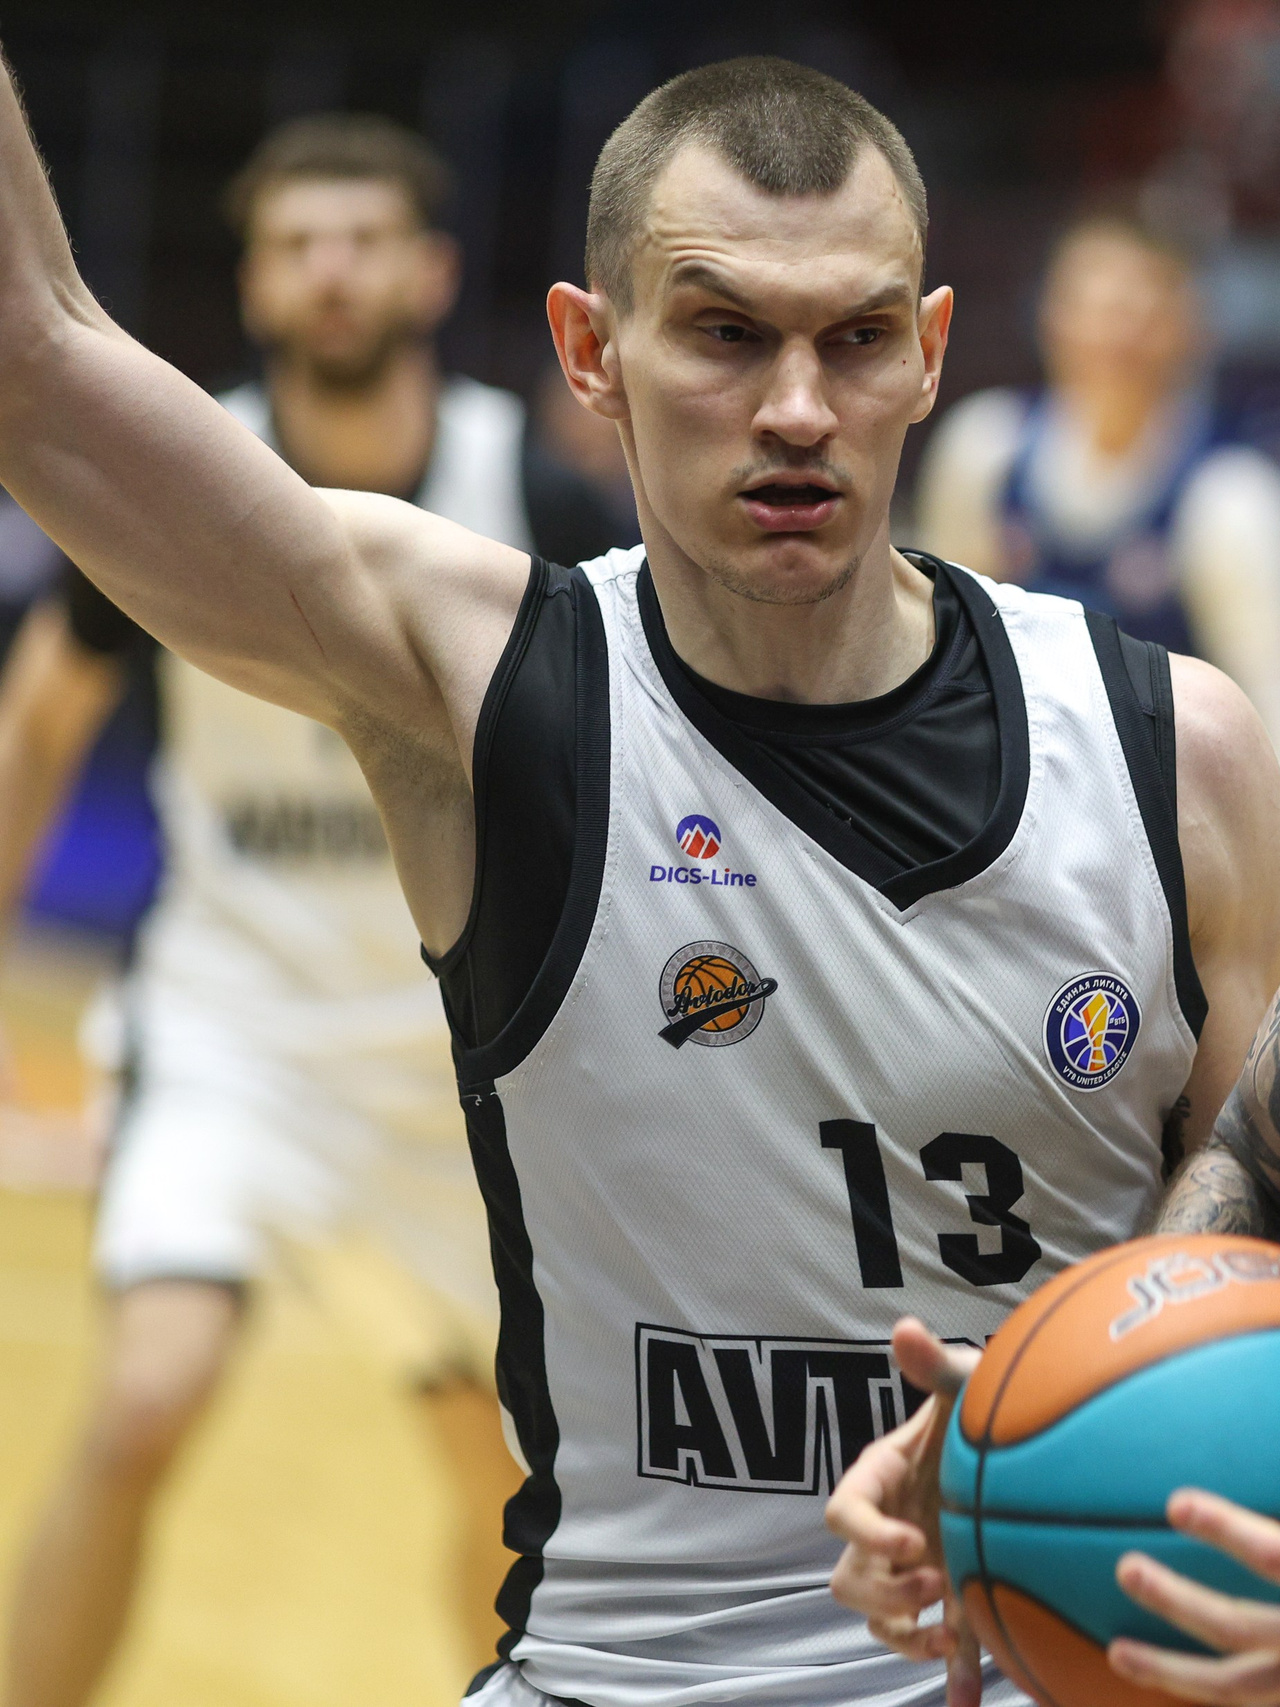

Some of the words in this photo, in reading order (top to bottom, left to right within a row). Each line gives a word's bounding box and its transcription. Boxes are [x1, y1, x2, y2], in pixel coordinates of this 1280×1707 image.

[649, 865, 757, 887] DIGS-Line
[1056, 980, 1091, 1013] ЕДИНАЯ
[1092, 979, 1116, 989] ЛИГА
[1115, 984, 1129, 1000] ВТБ
[1114, 1016, 1126, 1026] ВТБ
[1062, 1065, 1076, 1080] VTB
[1076, 1075, 1104, 1086] UNITED
[1103, 1051, 1128, 1080] LEAGUE
[818, 1118, 1042, 1288] 13
